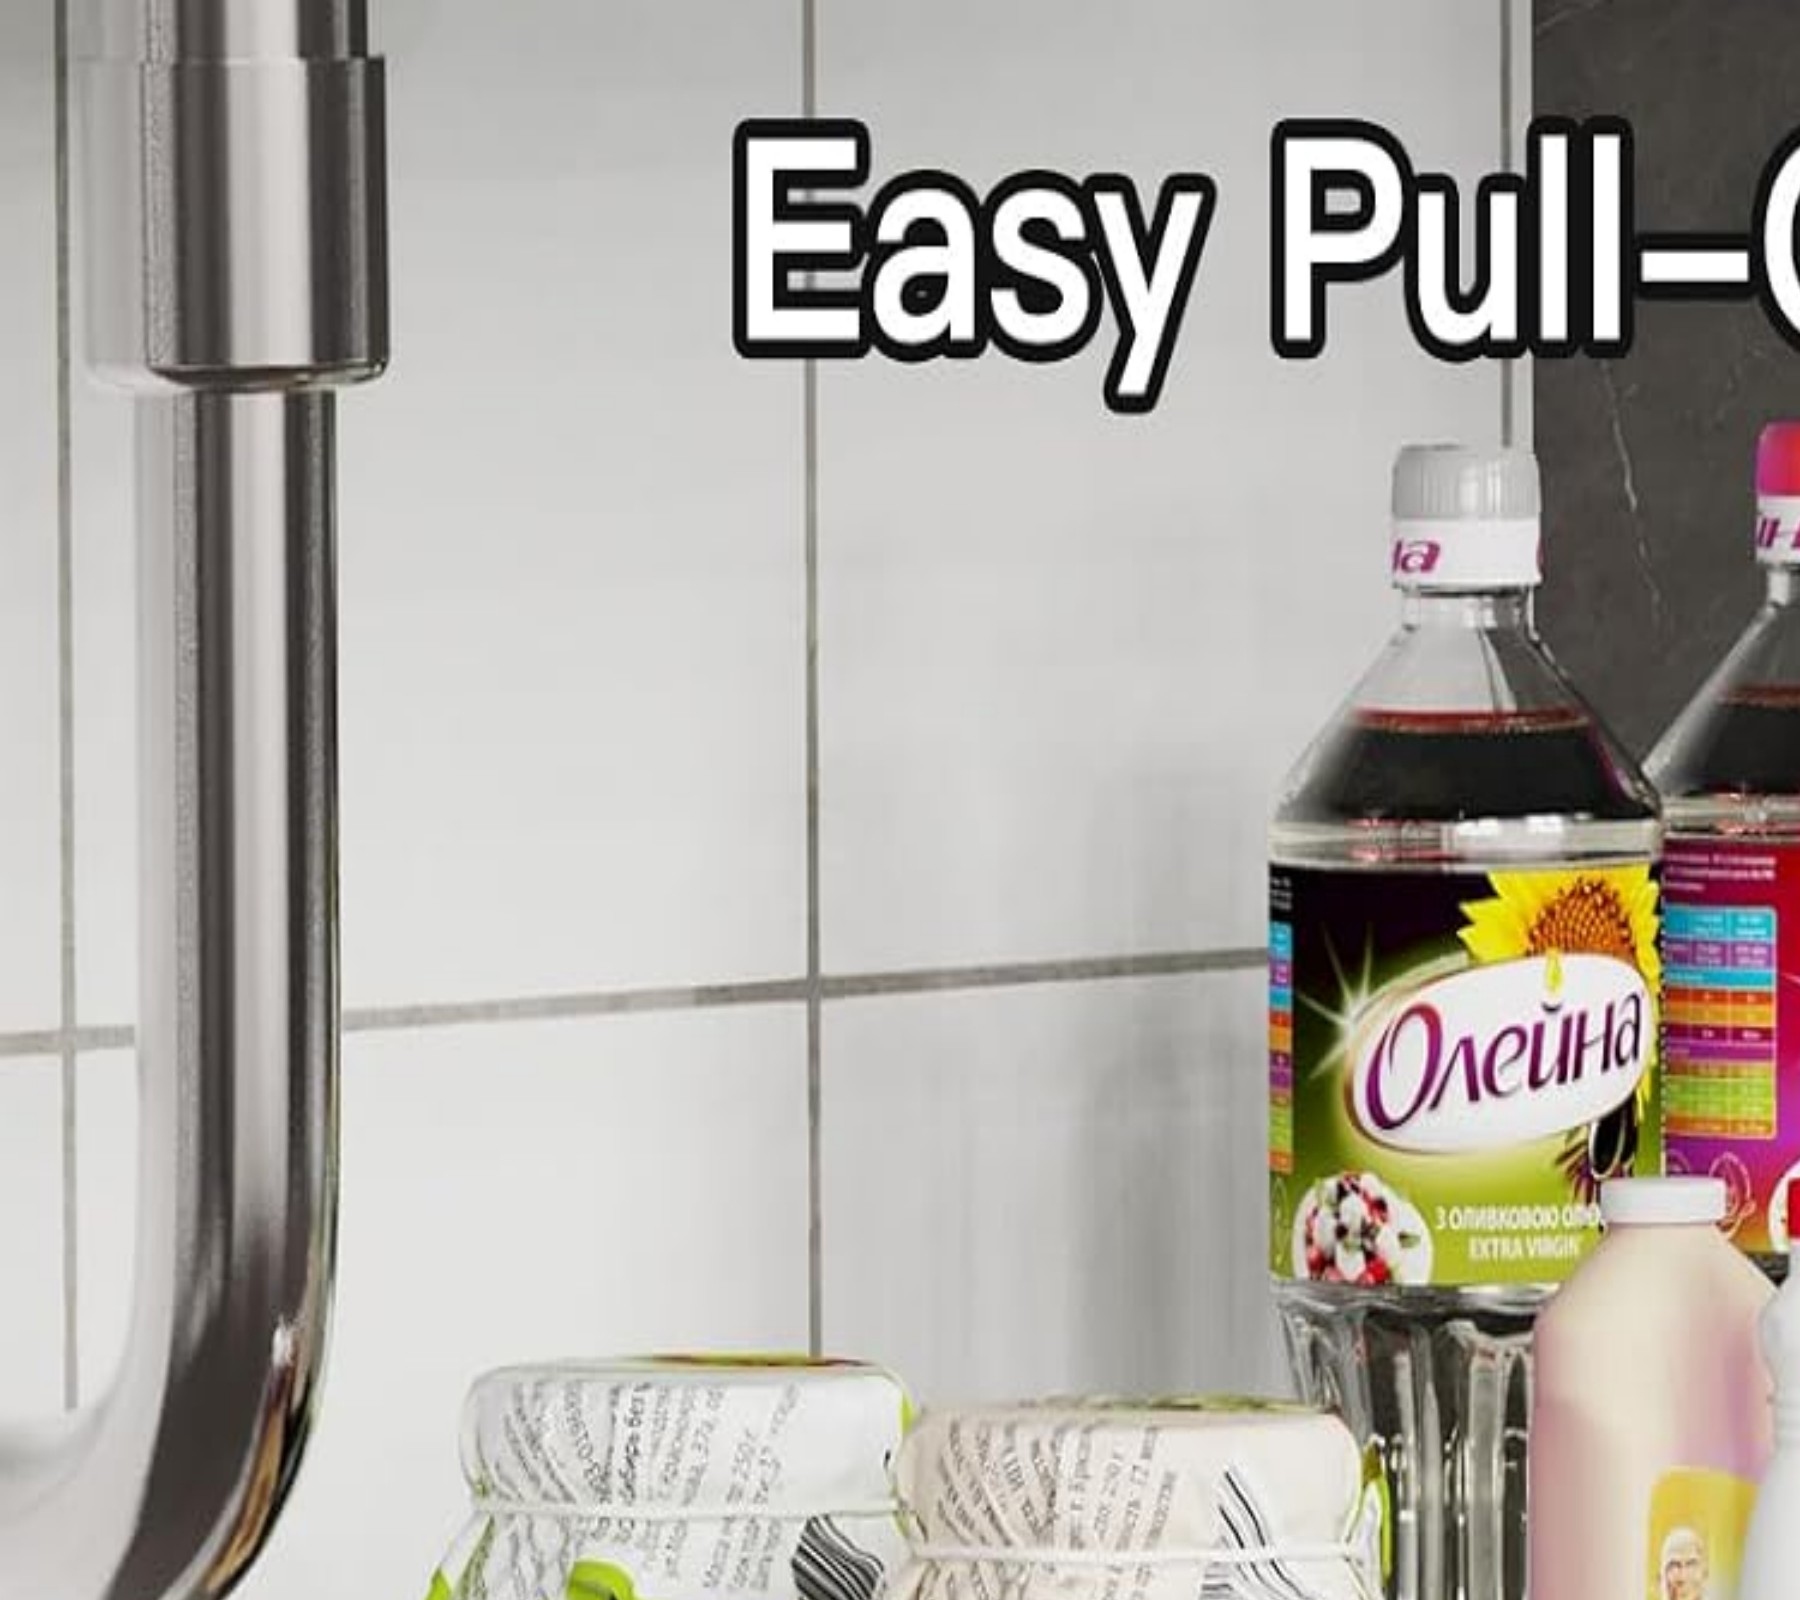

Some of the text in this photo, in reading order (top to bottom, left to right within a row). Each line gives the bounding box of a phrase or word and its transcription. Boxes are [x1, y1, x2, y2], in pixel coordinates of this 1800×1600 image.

[1364, 992, 1645, 1132] Олейна
[1469, 1234, 1581, 1262] EXTRA VIRGIN
